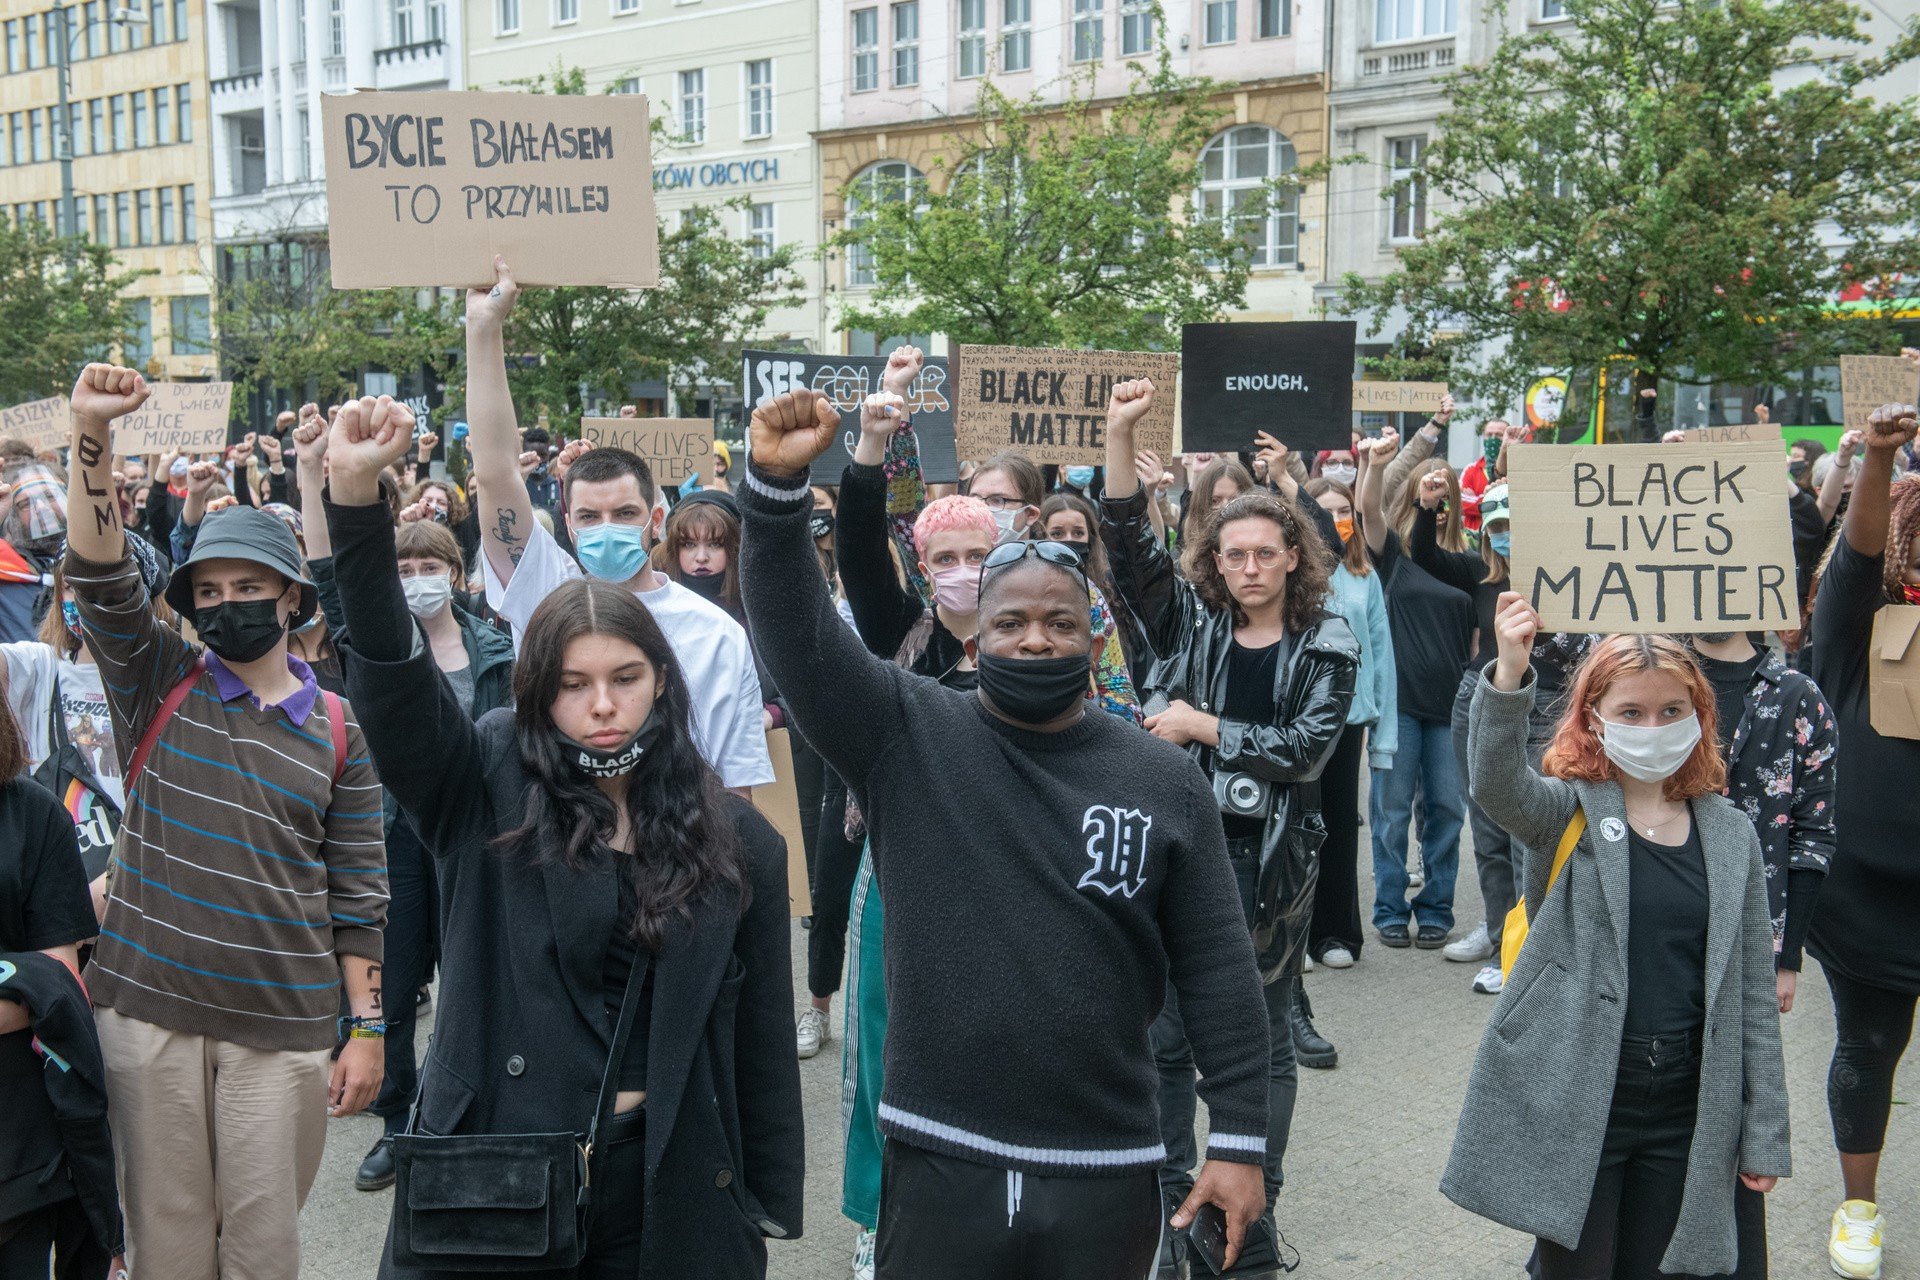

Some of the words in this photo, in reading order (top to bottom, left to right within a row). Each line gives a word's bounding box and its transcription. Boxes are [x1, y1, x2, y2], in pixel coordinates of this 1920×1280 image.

[345, 112, 446, 169] BYCIE
[469, 117, 614, 168] BIAŁASEM
[700, 158, 778, 186] OBCYCH
[385, 184, 441, 224] TO
[461, 183, 609, 220] PRZYWILEJ
[965, 346, 988, 355] GEORGE
[991, 346, 1010, 354] FLOYD
[1053, 348, 1078, 356] TAYLOR
[962, 357, 995, 365] TRAYVON
[1027, 357, 1052, 365] OSCAR
[1056, 357, 1077, 365] GRANT
[1081, 358, 1095, 366] ERIC
[1127, 360, 1162, 369] PHILANDO
[744, 357, 751, 408] I
[980, 368, 1067, 405] BLACK
[1153, 371, 1177, 380] SCOTT
[1225, 374, 1310, 393] ENOUGH.
[173, 385, 192, 396] DO
[203, 384, 227, 396] YOU
[1368, 387, 1397, 404] LIVES
[0, 398, 62, 431] ASIZM?
[180, 399, 224, 410] WHEN
[961, 410, 993, 422] SMART
[122, 413, 185, 430] POLICE
[1011, 412, 1106, 449] MATTE
[143, 428, 225, 447] MURDER?
[653, 430, 709, 457] LIVES
[1138, 430, 1171, 440] FOSTER
[1699, 425, 1751, 442] BLACK
[1036, 449, 1083, 462] CRAWFORD
[78, 432, 118, 536] BLM
[1573, 460, 1746, 507] BLACK
[1586, 513, 1733, 555] LIVES
[1532, 562, 1787, 622] MATTER
[579, 741, 644, 768] BLACK
